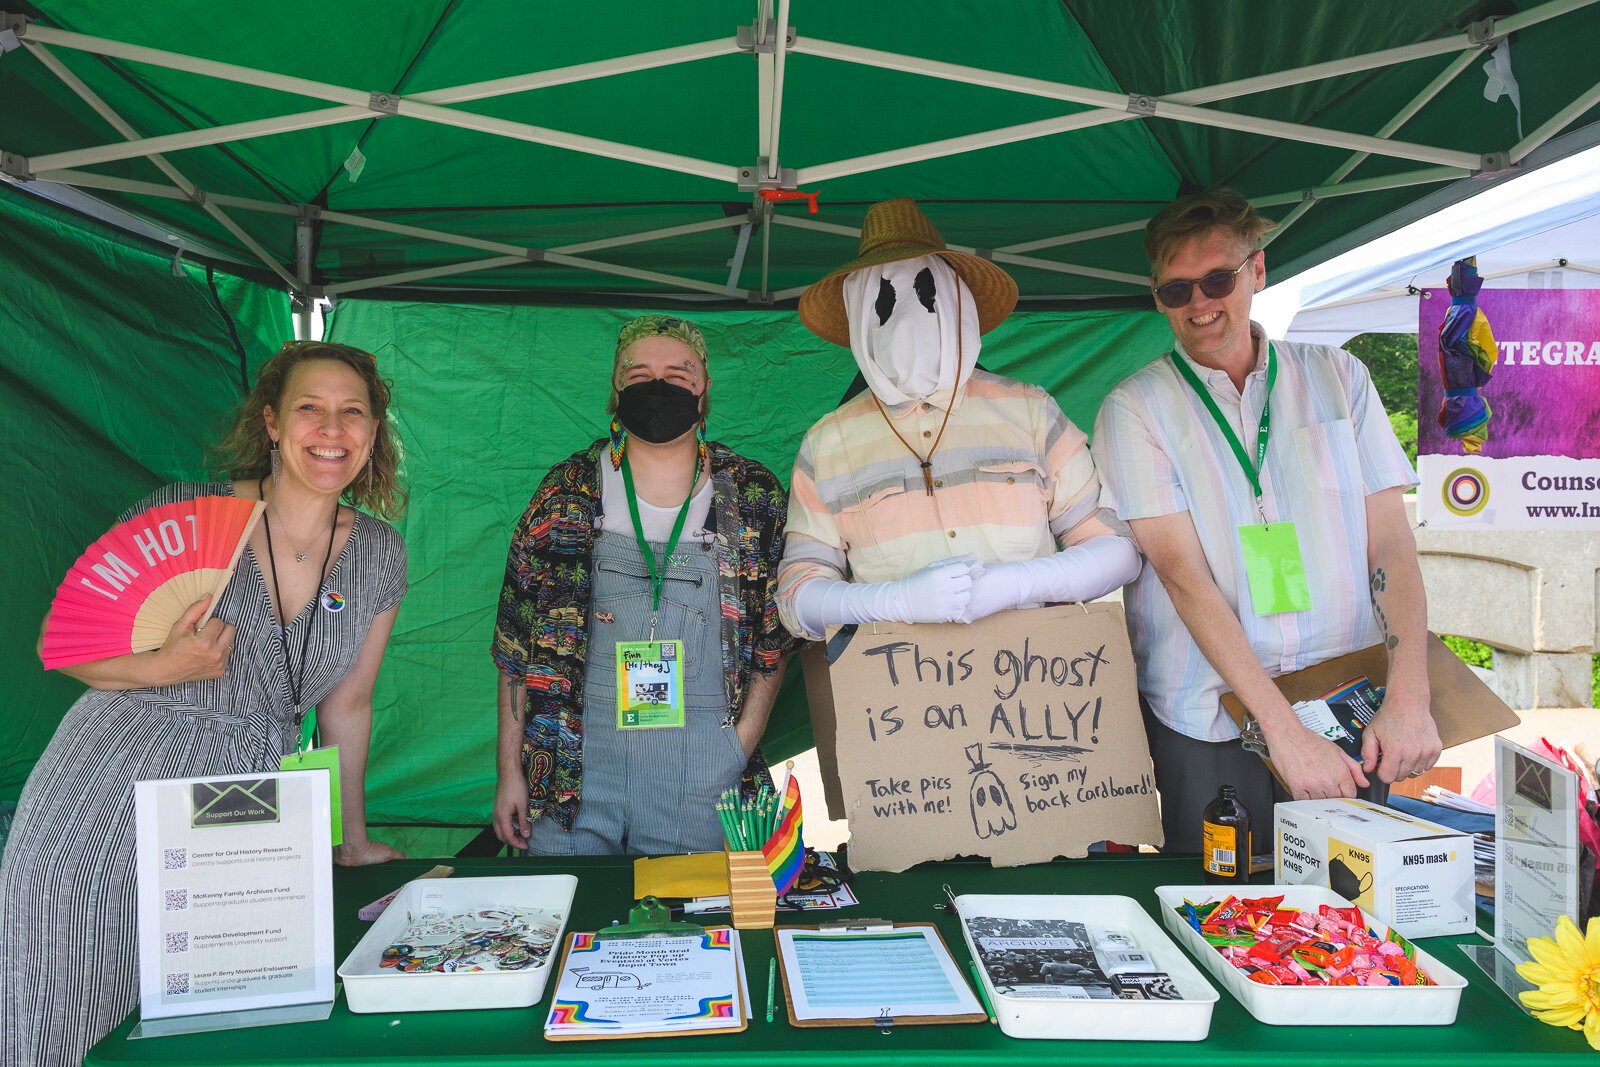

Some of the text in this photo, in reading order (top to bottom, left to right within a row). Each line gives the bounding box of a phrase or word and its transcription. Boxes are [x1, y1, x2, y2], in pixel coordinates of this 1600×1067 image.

[1494, 341, 1600, 366] TEGRA
[1522, 471, 1600, 490] Couns
[80, 550, 140, 601] I'M
[623, 650, 642, 660] Finn
[862, 637, 1110, 700] This ghost
[627, 714, 634, 722] E
[866, 697, 1102, 744] is an ALLY!
[1067, 765, 1089, 786] my
[866, 776, 952, 800] Take pics
[924, 798, 953, 816] me!
[1025, 792, 1071, 813] back
[206, 810, 232, 819] Support
[1283, 832, 1306, 849] GOOD
[192, 851, 214, 859] Center
[239, 848, 262, 857] History
[1283, 846, 1321, 869] COMFORT
[1349, 848, 1370, 864] KN95
[1403, 852, 1448, 866] KN95 mask
[1283, 858, 1303, 874] KN95
[193, 892, 222, 901] McKenny
[224, 890, 244, 899] Family
[246, 888, 272, 896] Archives
[194, 933, 221, 941] Archives
[222, 930, 264, 940] Development
[234, 938, 264, 948] University
[265, 936, 288, 945] support
[235, 966, 262, 975] Memorial
[263, 964, 298, 972] Endowment
